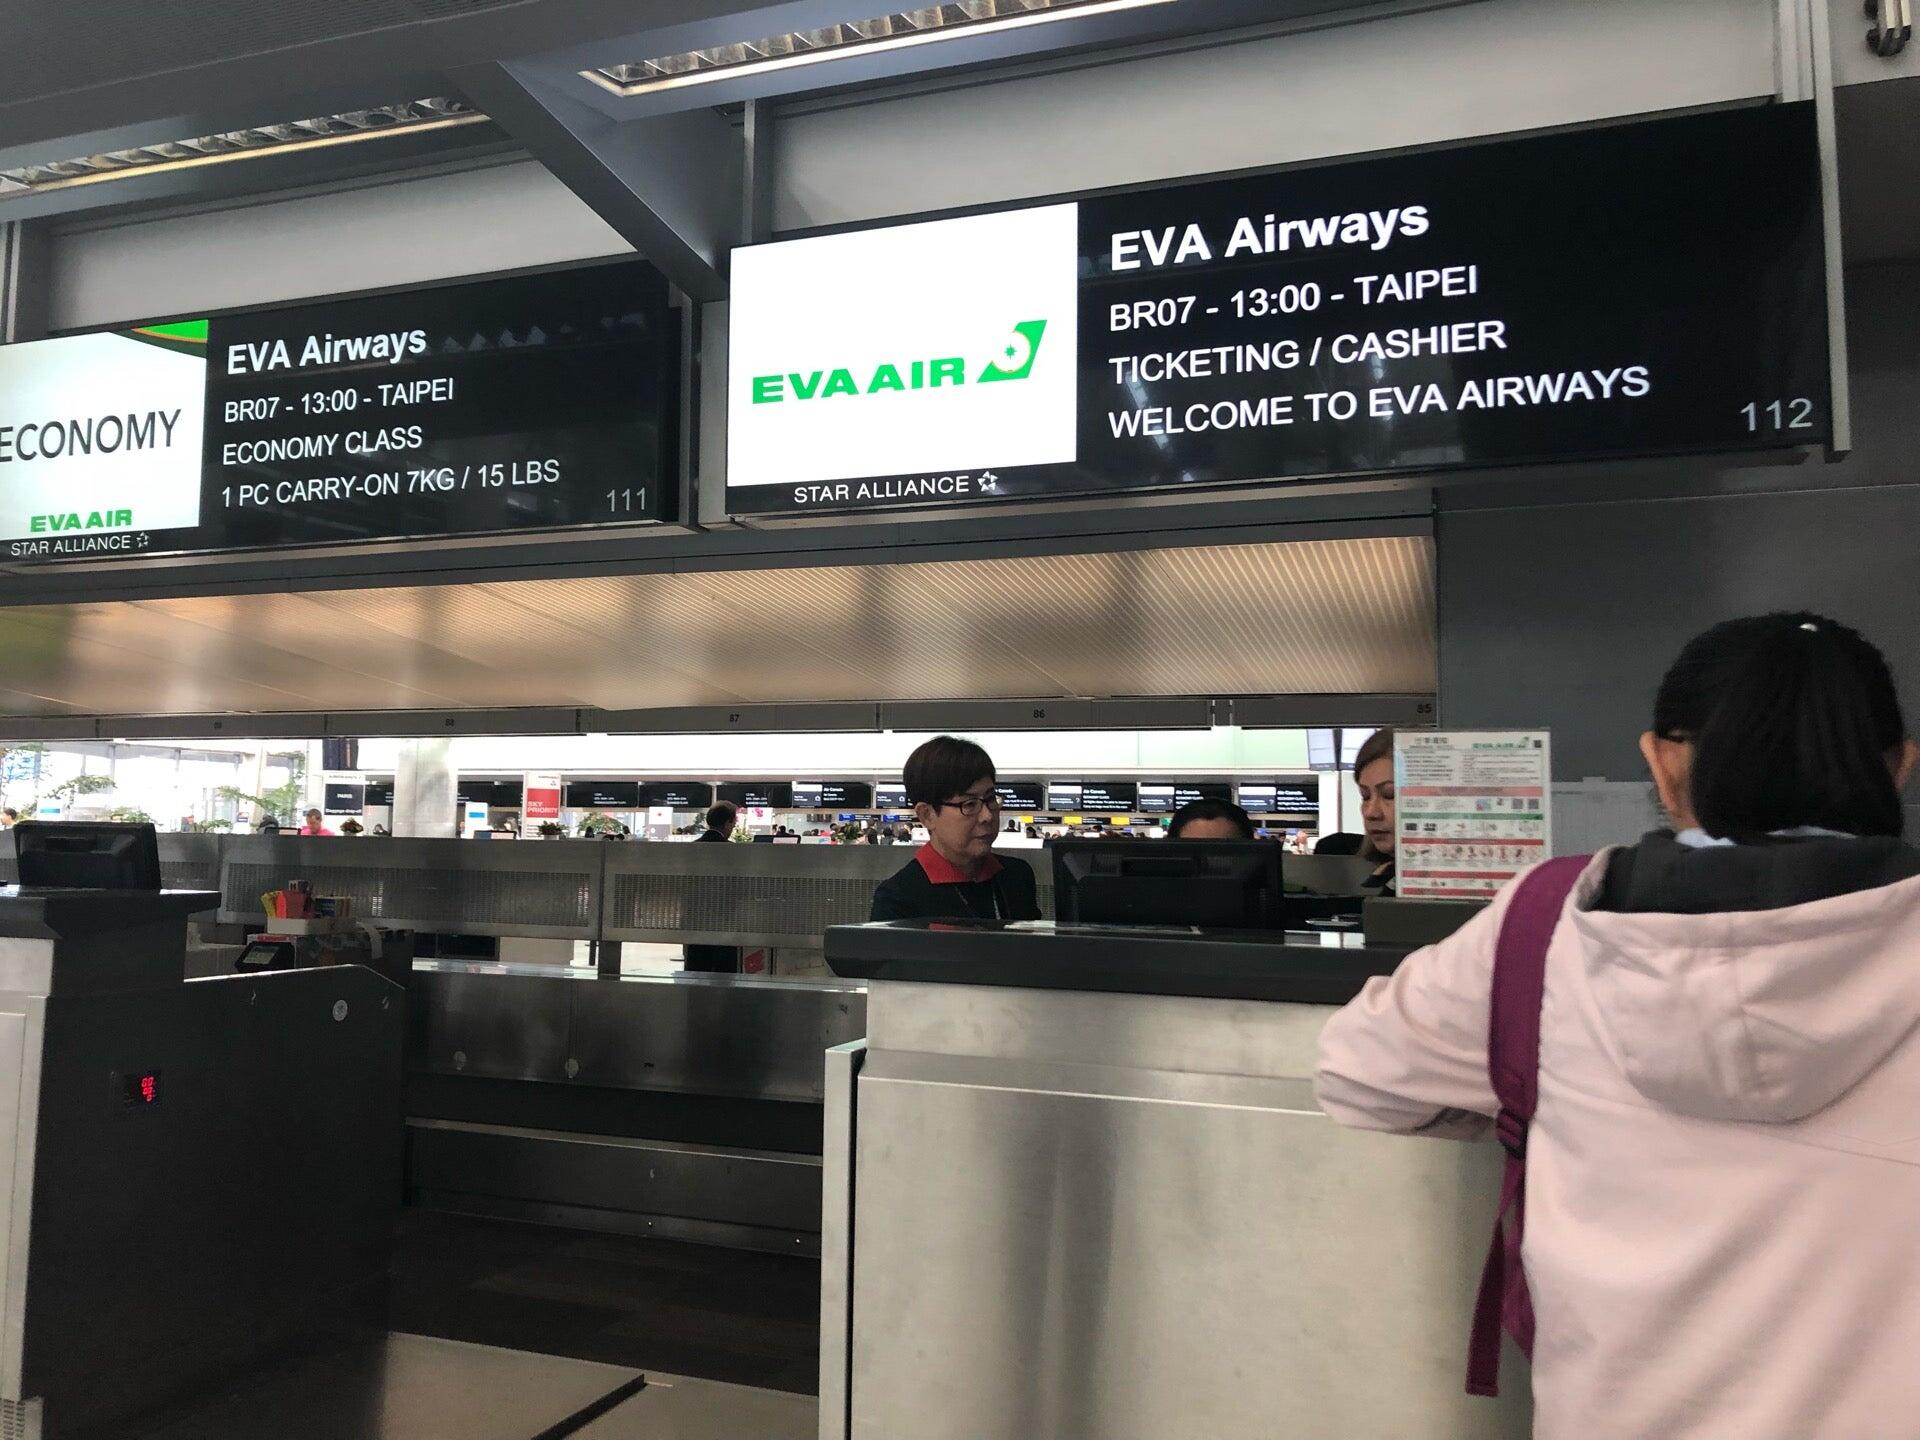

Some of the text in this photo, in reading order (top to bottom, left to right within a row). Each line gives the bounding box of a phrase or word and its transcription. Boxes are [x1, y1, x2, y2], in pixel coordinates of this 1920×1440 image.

[1111, 205, 1430, 271] EVA Airways
[1110, 295, 1197, 332] BR07
[1230, 282, 1321, 318] 13:00
[1330, 293, 1345, 301] -
[1353, 265, 1477, 305] TAIPEI
[227, 329, 427, 375] EVA Airways
[1108, 320, 1507, 385] TICKETING / CASHIER
[224, 396, 281, 423] BR07
[301, 388, 358, 415] 13:00
[377, 377, 454, 407] TAIPEI
[751, 356, 965, 404] EVA AIR
[1108, 365, 1650, 440] WELCOME TO EVA AIRWAYS
[0, 409, 181, 465] ECONOMY
[1740, 397, 1814, 431] 112
[222, 425, 423, 466] ECONOMY CLASS
[222, 458, 560, 508] 1 PC CARRY-ON 7KG / 15 LBS
[606, 487, 646, 512] 111
[793, 475, 971, 504] STAR ALLIANCE
[30, 509, 132, 533] EVA AIR
[10, 534, 132, 557] STAR ALLIANCE
[1033, 708, 1046, 719] 86
